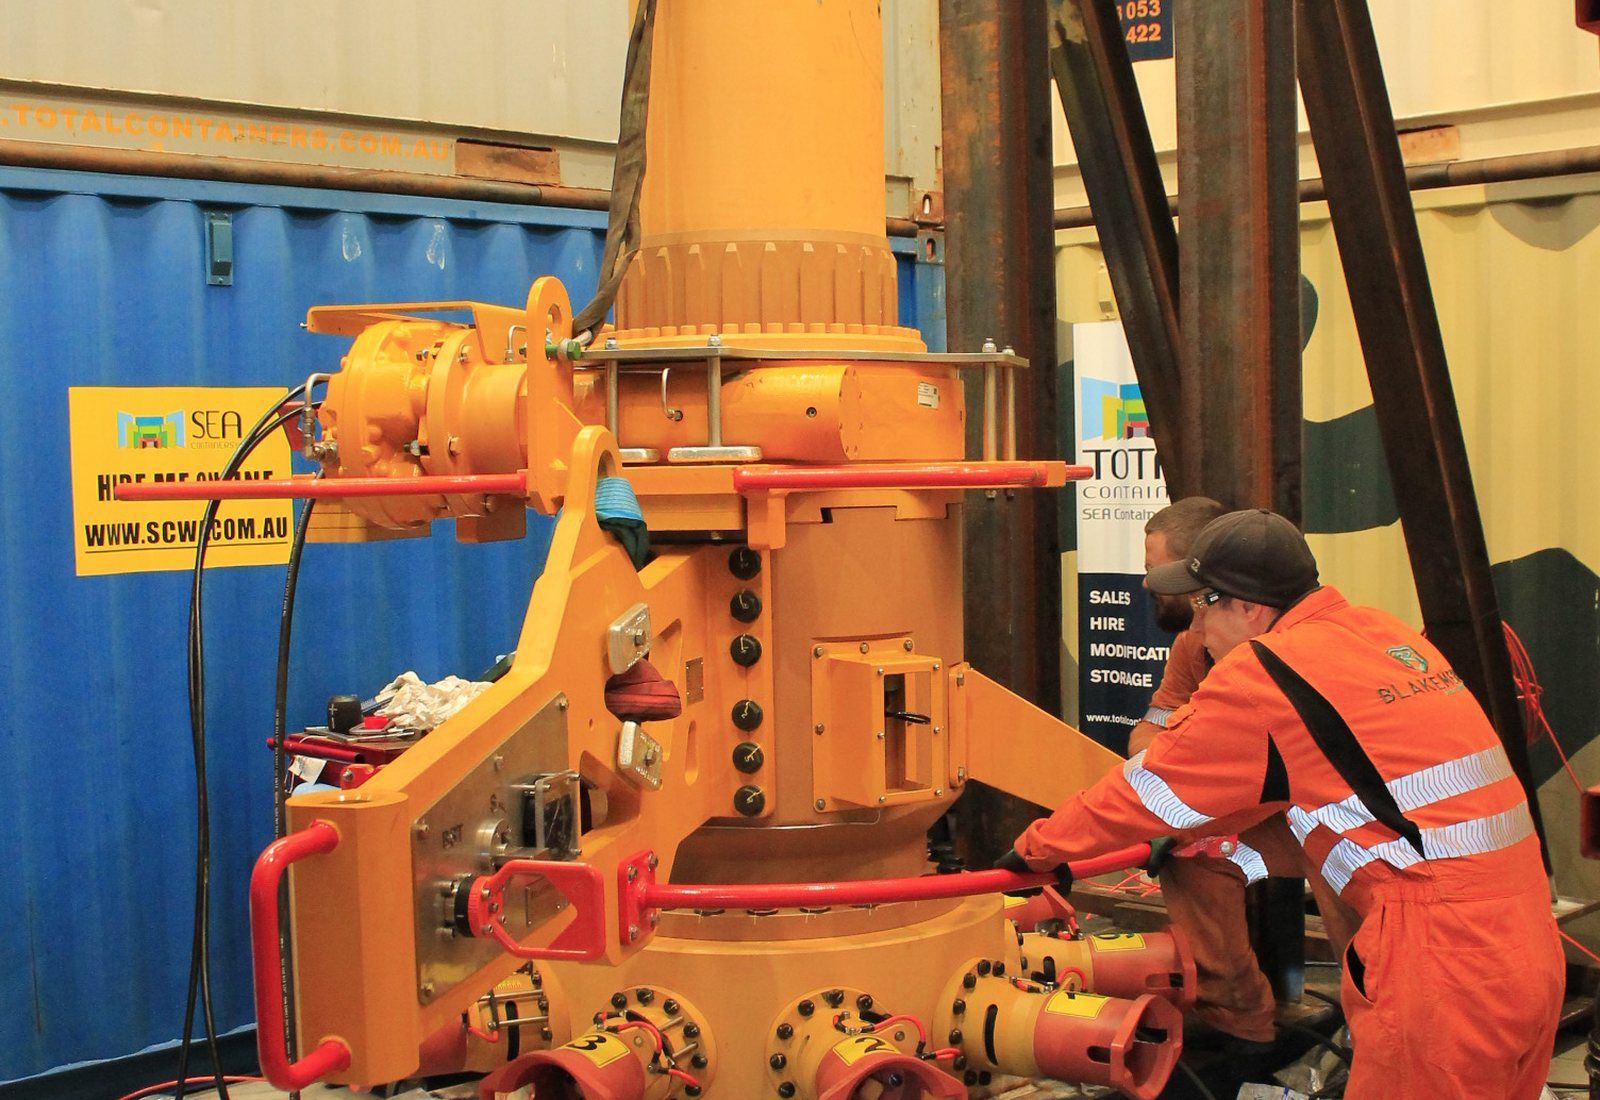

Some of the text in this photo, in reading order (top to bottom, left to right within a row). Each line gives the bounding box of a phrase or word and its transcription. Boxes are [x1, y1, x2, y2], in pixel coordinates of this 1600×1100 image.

[1126, 22, 1162, 44] 422
[191, 410, 242, 439] SEA
[1082, 508, 1112, 520] SEA
[1089, 590, 1131, 606] SALES
[1089, 616, 1125, 631] HIRE
[1089, 669, 1153, 687] STORAGE
[566, 1034, 607, 1051] 3
[853, 1035, 896, 1054] 2
